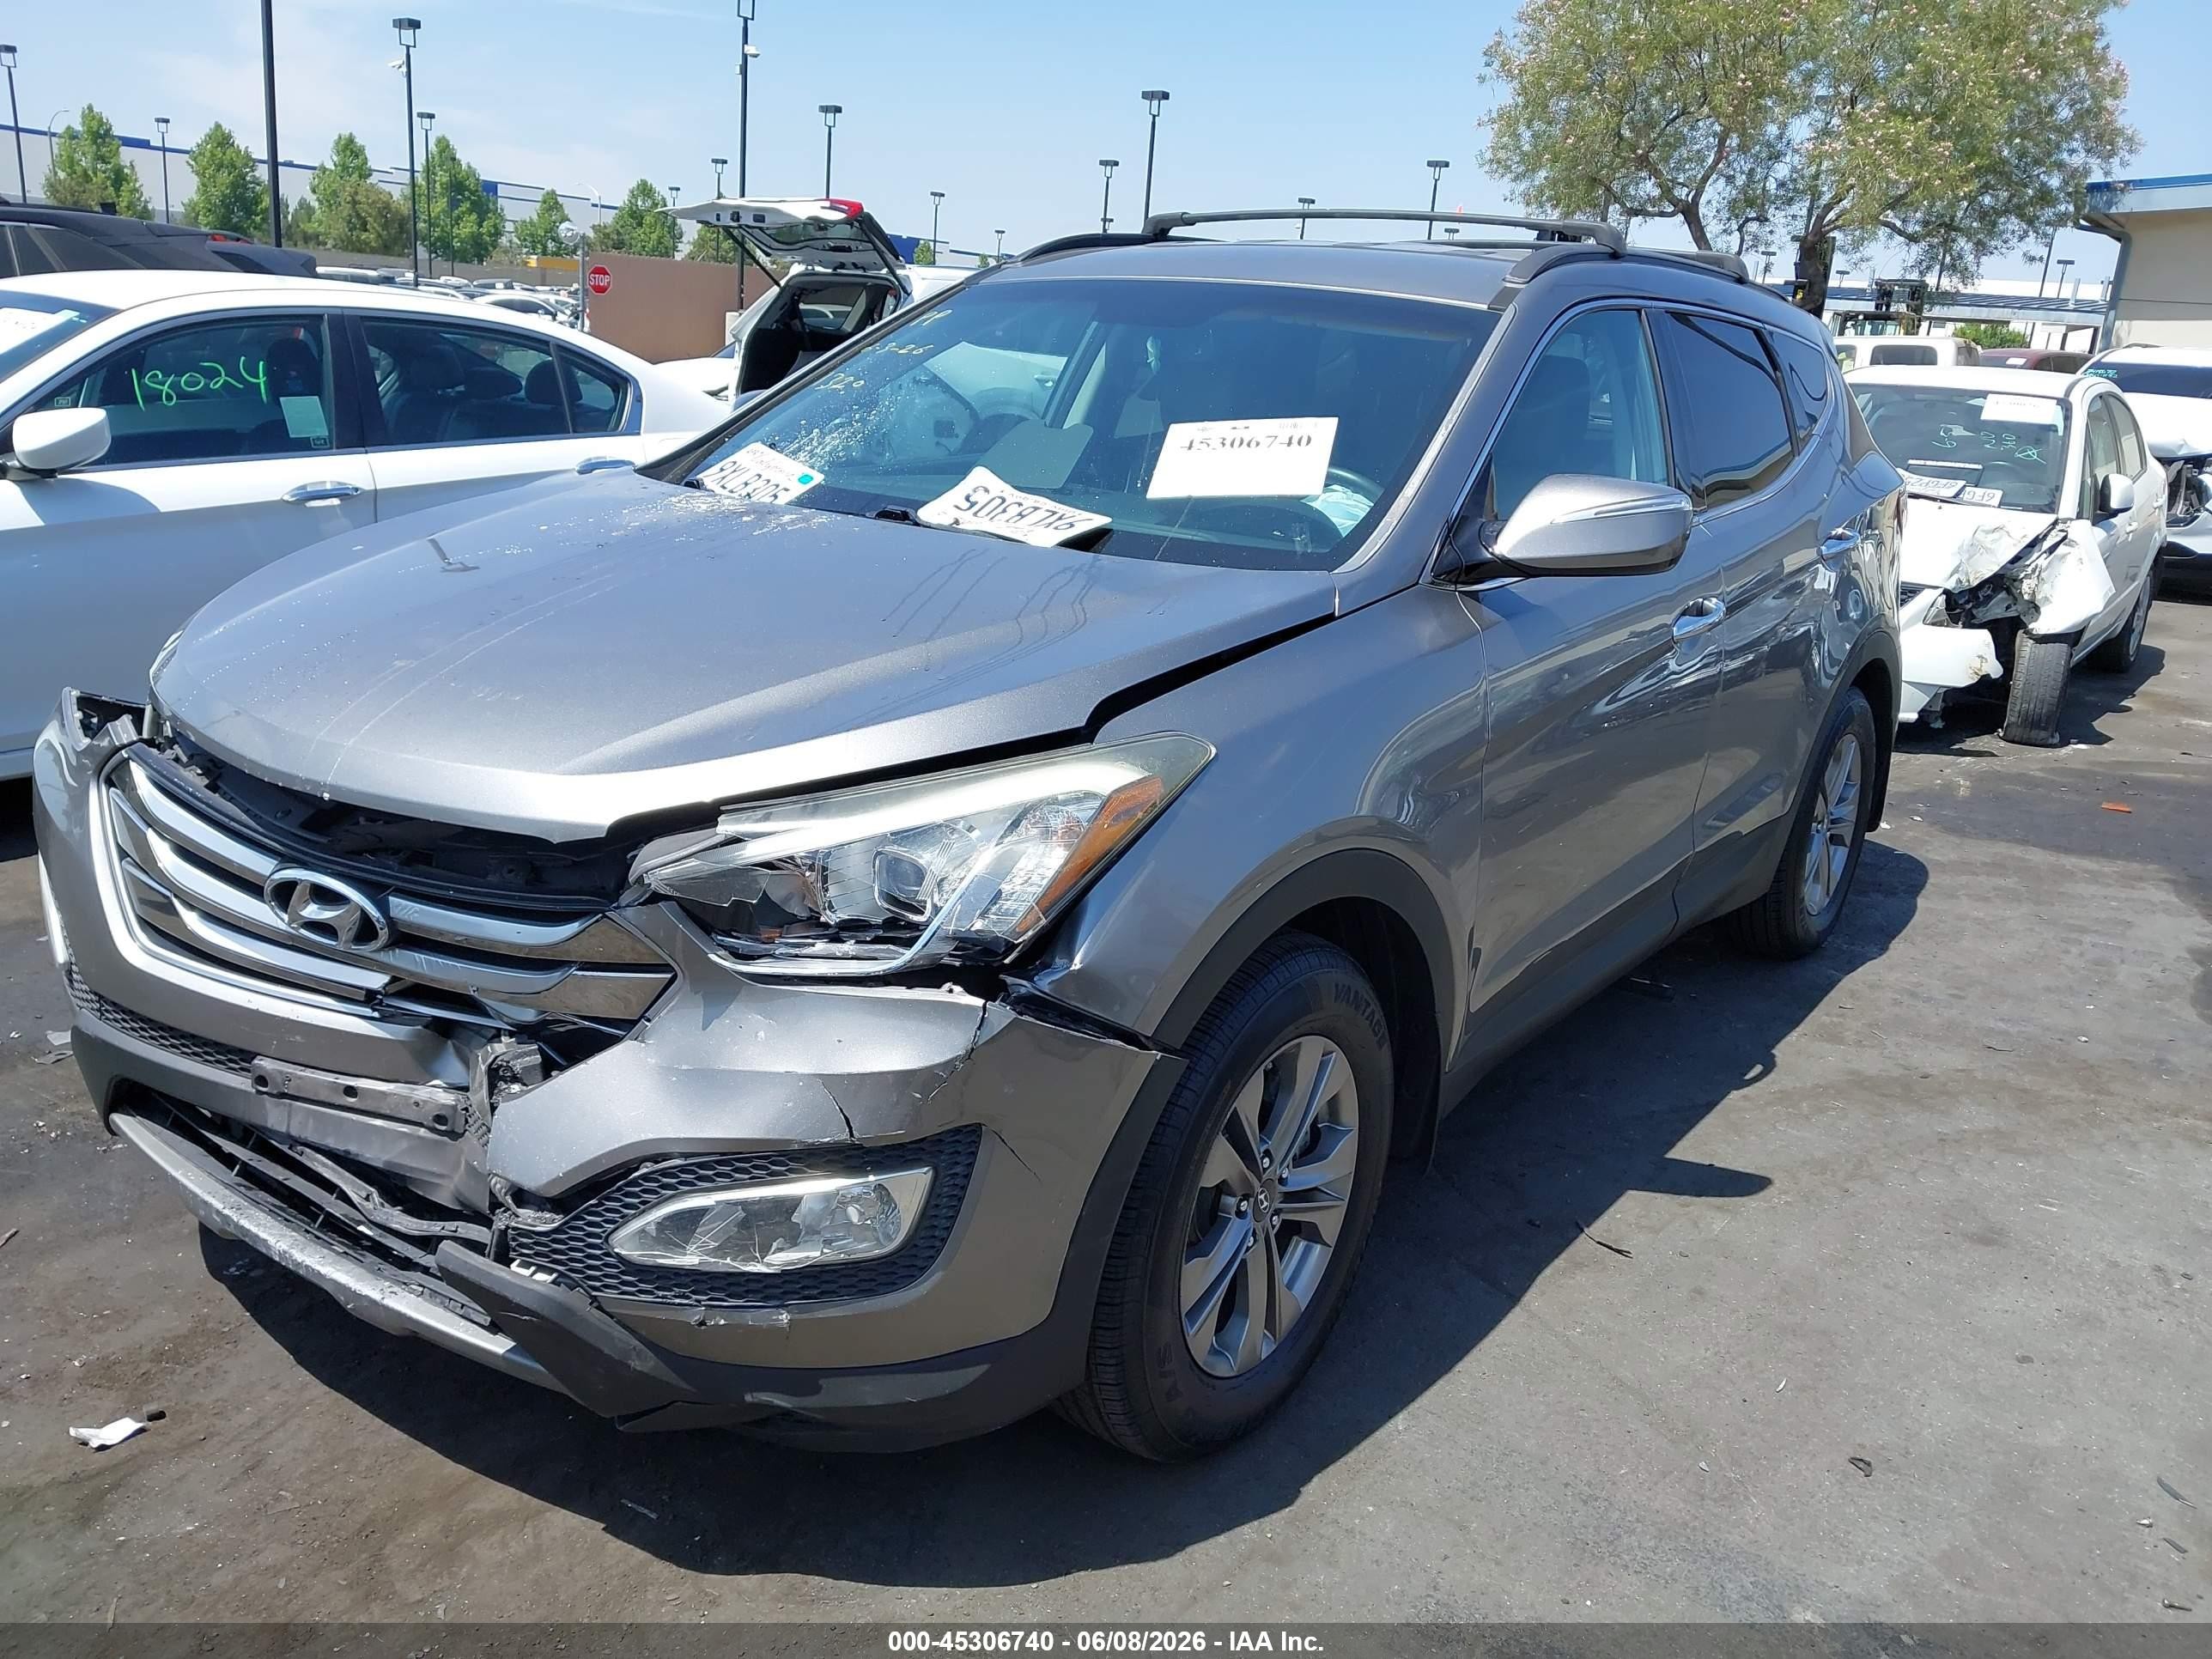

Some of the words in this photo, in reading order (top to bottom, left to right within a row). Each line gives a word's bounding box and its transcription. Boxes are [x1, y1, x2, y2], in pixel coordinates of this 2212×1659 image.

[589, 274, 611, 286] STOP
[131, 356, 267, 412] 18024
[1180, 434, 1312, 451] 45306740
[703, 460, 791, 504] 9XLB305
[952, 485, 1093, 531] 9XLB305
[1333, 982, 1389, 1050] VANTAGE
